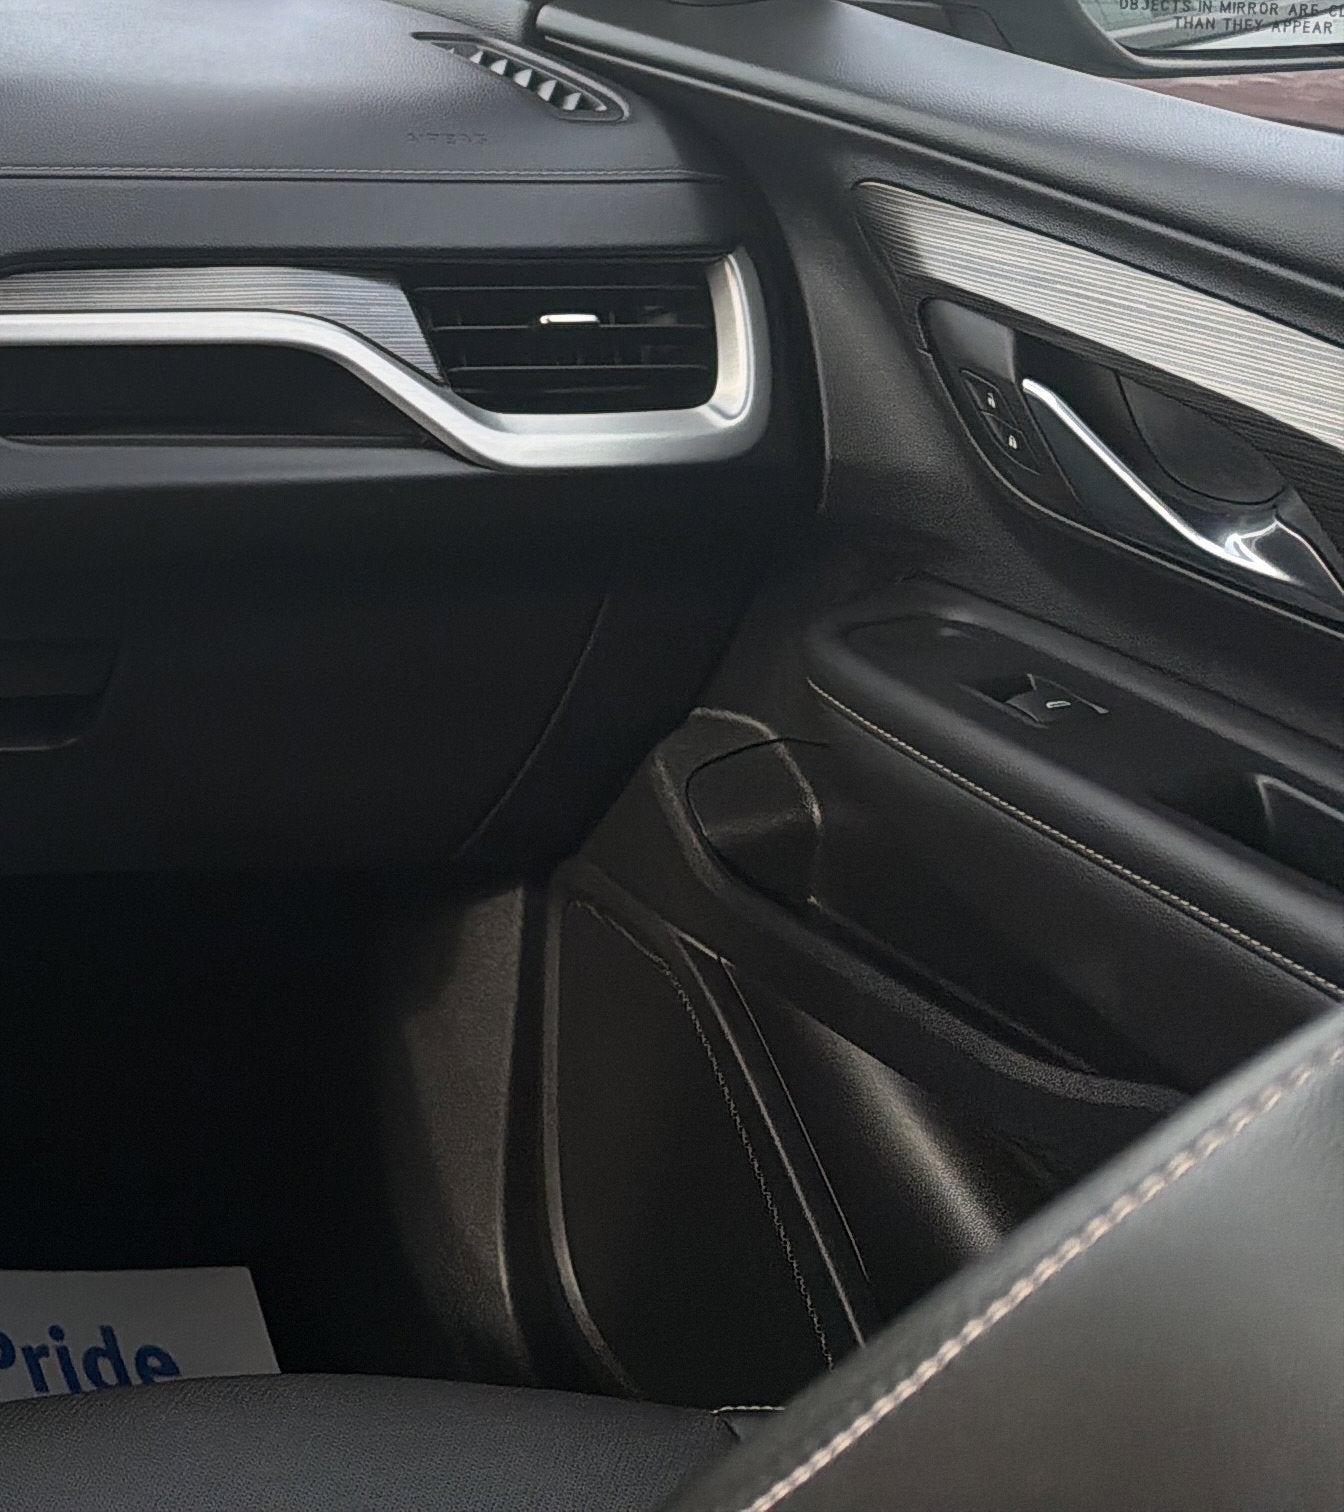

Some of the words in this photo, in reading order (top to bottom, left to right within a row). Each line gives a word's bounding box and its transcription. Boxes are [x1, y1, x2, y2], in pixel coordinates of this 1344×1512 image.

[1198, 0, 1213, 13] IN
[1219, 0, 1280, 16] MIRROR
[1287, 4, 1319, 17] ARE
[1174, 16, 1216, 31] THAN
[1222, 17, 1264, 32] THEY
[1271, 18, 1334, 35] APPEAR
